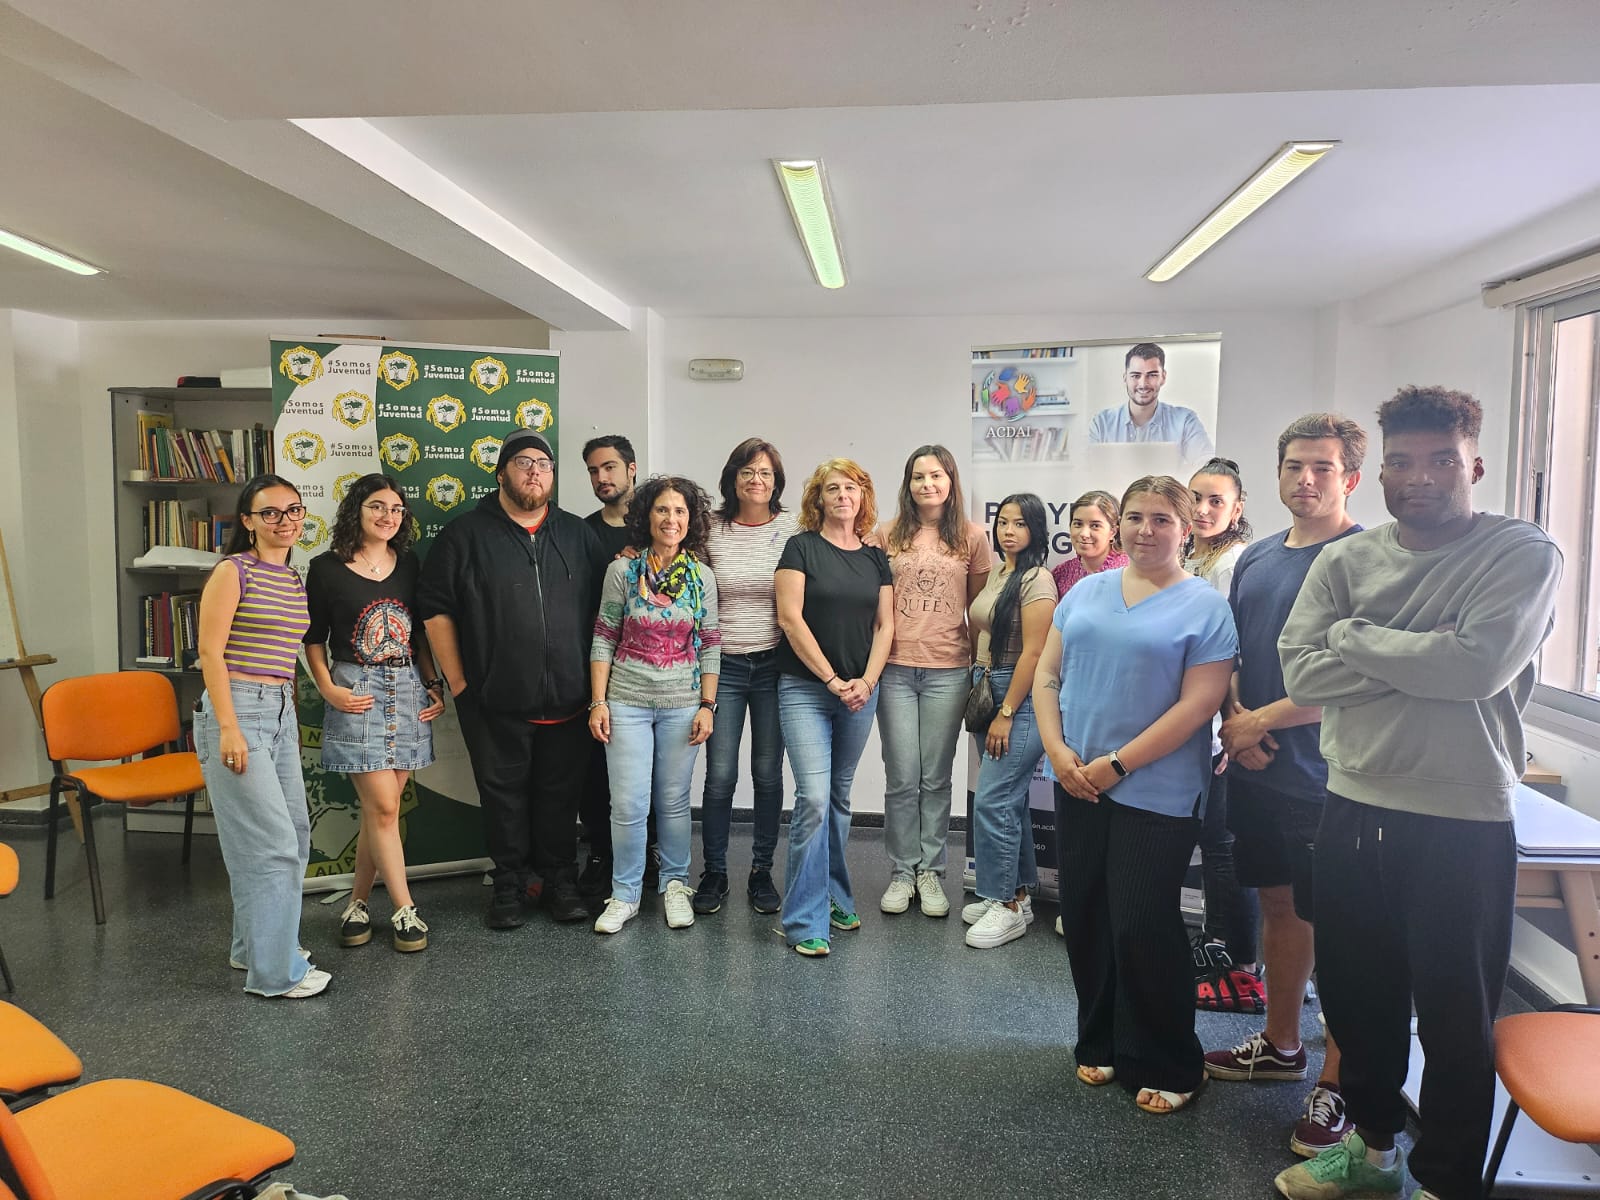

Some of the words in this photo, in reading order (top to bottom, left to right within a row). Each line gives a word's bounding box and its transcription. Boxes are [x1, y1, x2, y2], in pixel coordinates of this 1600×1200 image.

[328, 360, 371, 368] #Somos
[424, 364, 465, 372] #Somos
[328, 367, 371, 375] Juventud
[516, 369, 555, 377] #Somos
[423, 371, 465, 380] Juventud
[515, 376, 555, 384] Juventud
[378, 403, 422, 411] #Somos
[471, 407, 511, 415] #Somos
[378, 410, 422, 419] Juventud
[471, 414, 511, 422] Juventud
[330, 442, 373, 450] #Somos
[424, 445, 465, 453] #Somos
[424, 451, 465, 460] Juventud
[896, 597, 956, 618] QUEEN
